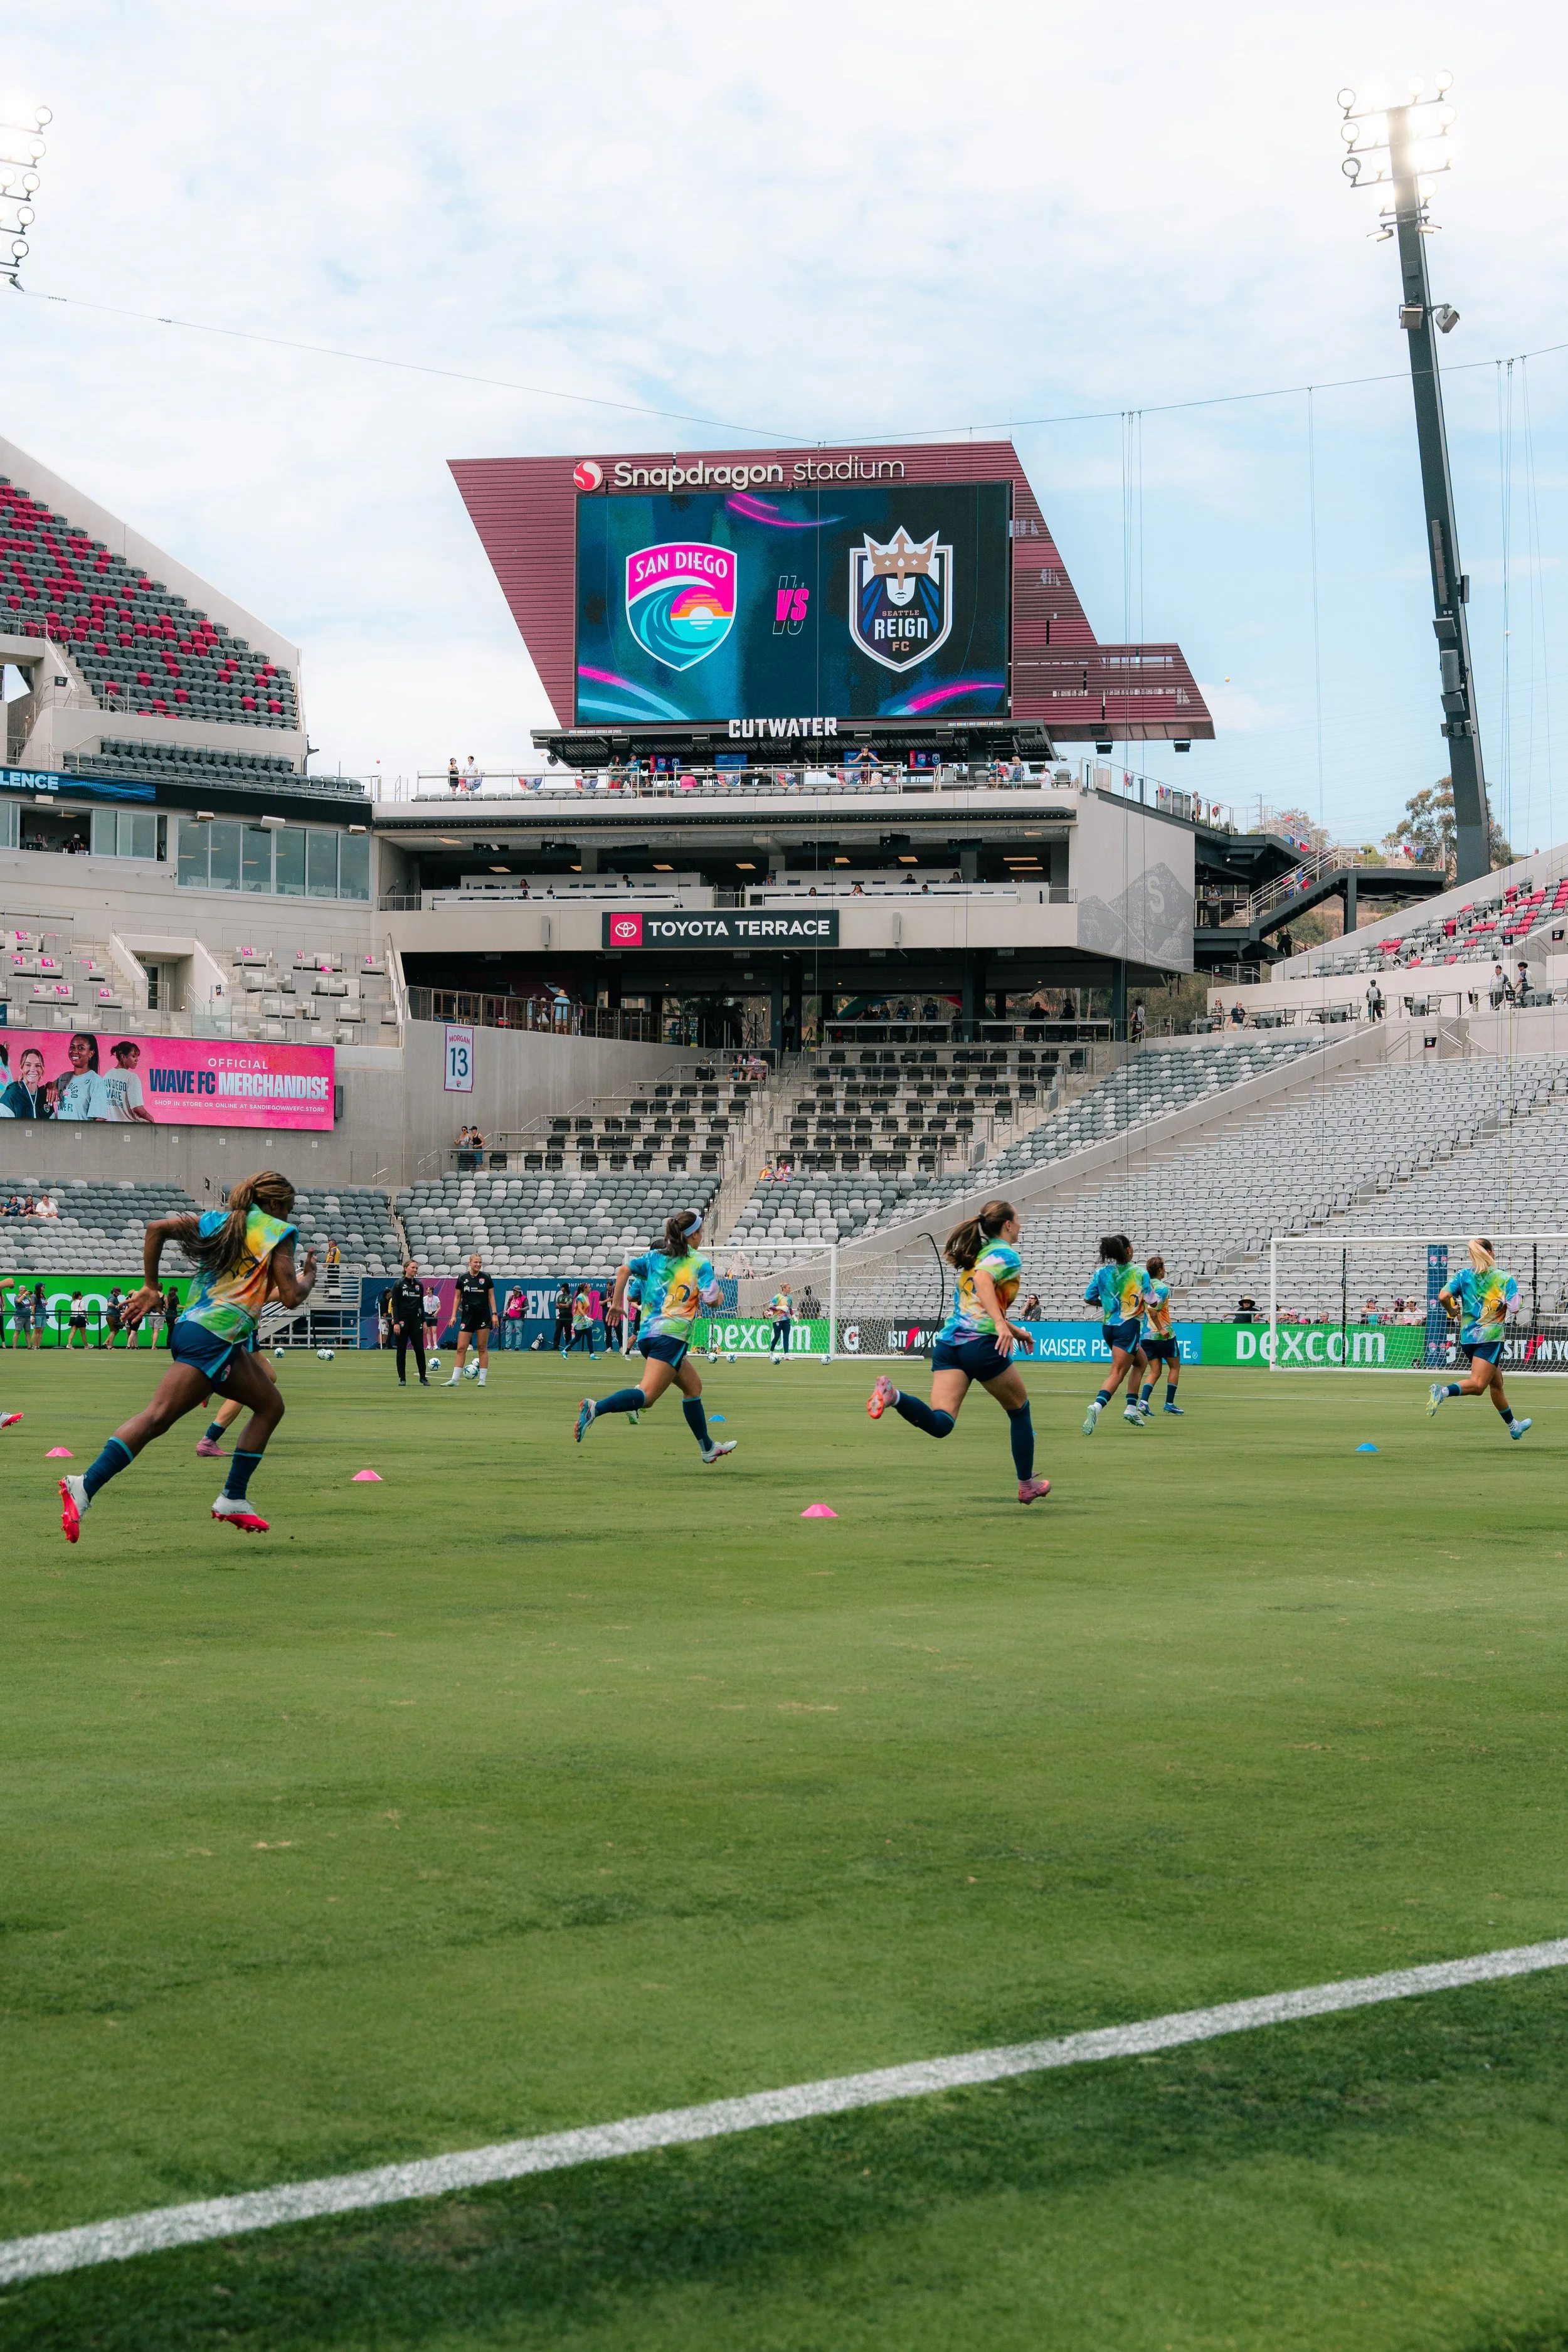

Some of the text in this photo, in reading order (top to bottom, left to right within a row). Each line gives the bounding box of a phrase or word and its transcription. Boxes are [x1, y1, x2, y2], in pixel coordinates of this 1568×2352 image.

[614, 455, 904, 492] Snapdragon stadium
[635, 552, 728, 582] SAN DIEGO
[776, 588, 809, 620] VS
[874, 618, 928, 640] REIGN
[892, 641, 909, 652] FC
[728, 718, 837, 738] CUTWATER
[649, 920, 829, 936] TOYOTA TERRACE
[449, 1035, 470, 1045] MORGAN
[208, 1058, 268, 1069] OFFICIAL
[450, 1047, 468, 1077] 13
[149, 1068, 329, 1099] WAVE FC MERCHANDISE
[249, 1104, 325, 1112] SANDIEGOWAVEFC.STORE
[1040, 1338, 1086, 1357] KAISER
